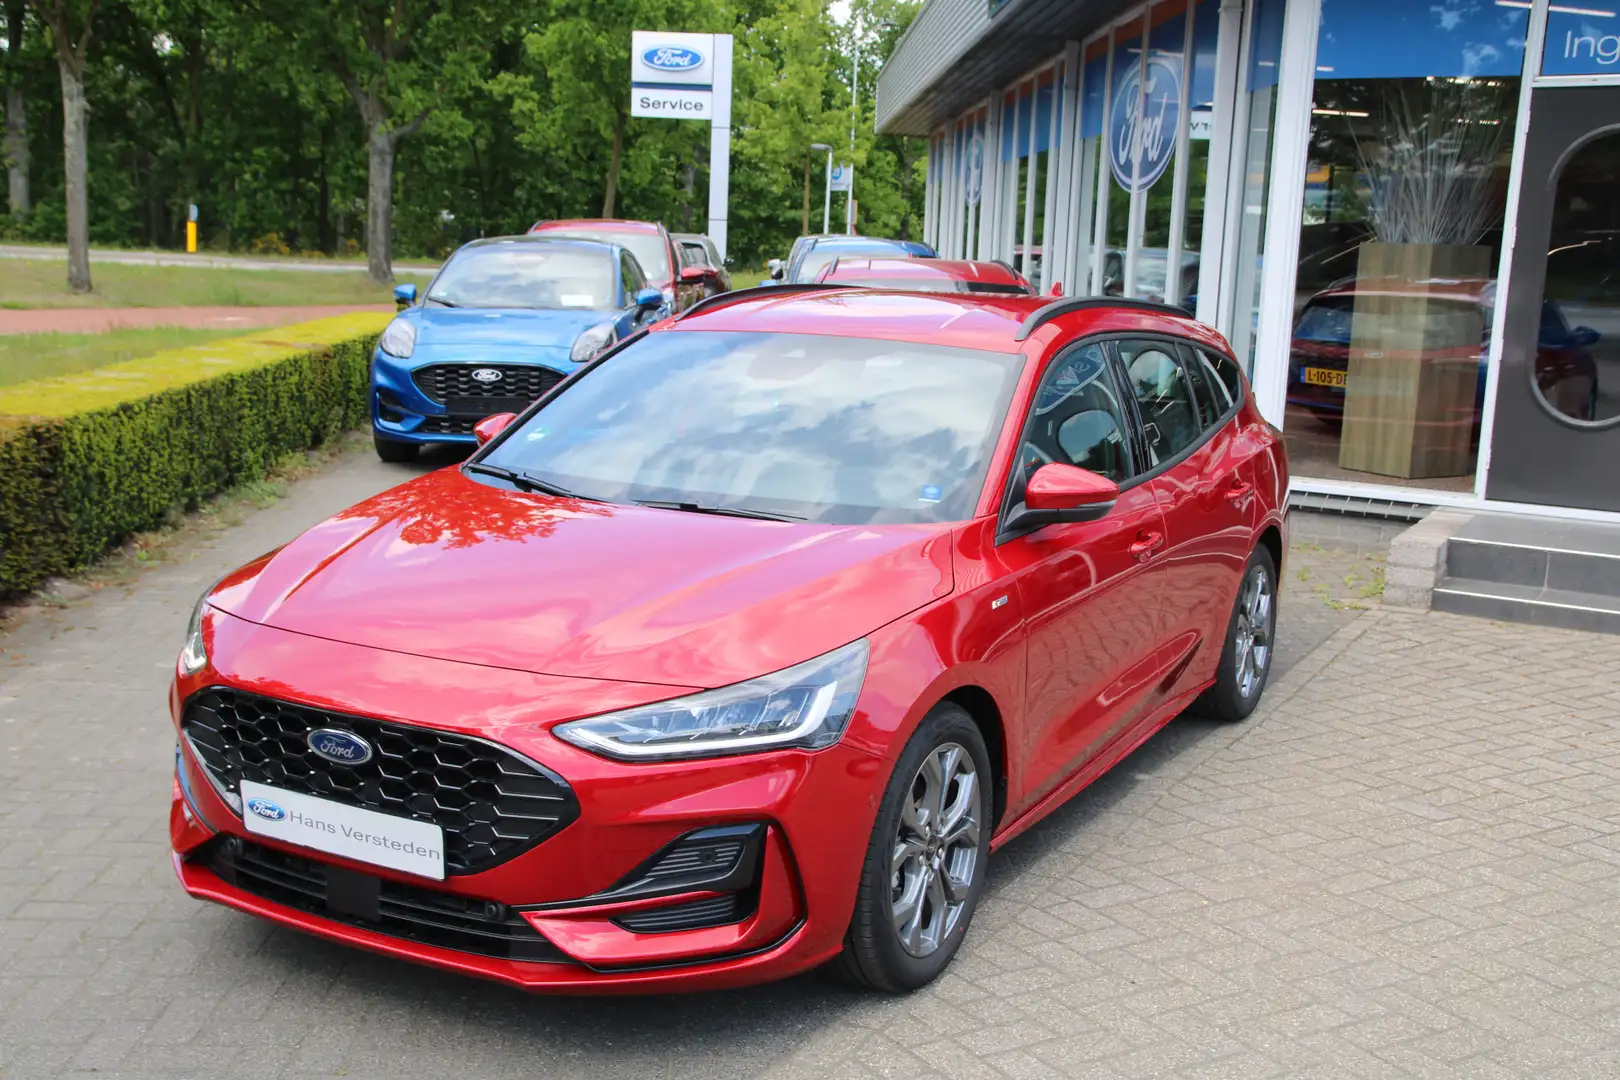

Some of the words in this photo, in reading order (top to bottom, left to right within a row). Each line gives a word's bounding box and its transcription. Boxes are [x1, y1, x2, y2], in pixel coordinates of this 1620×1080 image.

[652, 47, 692, 66] Ford
[639, 96, 704, 111] Service
[319, 735, 355, 760] Ford
[252, 799, 281, 820] Ford
[289, 809, 337, 835] Hans
[340, 823, 441, 861] Versteden
